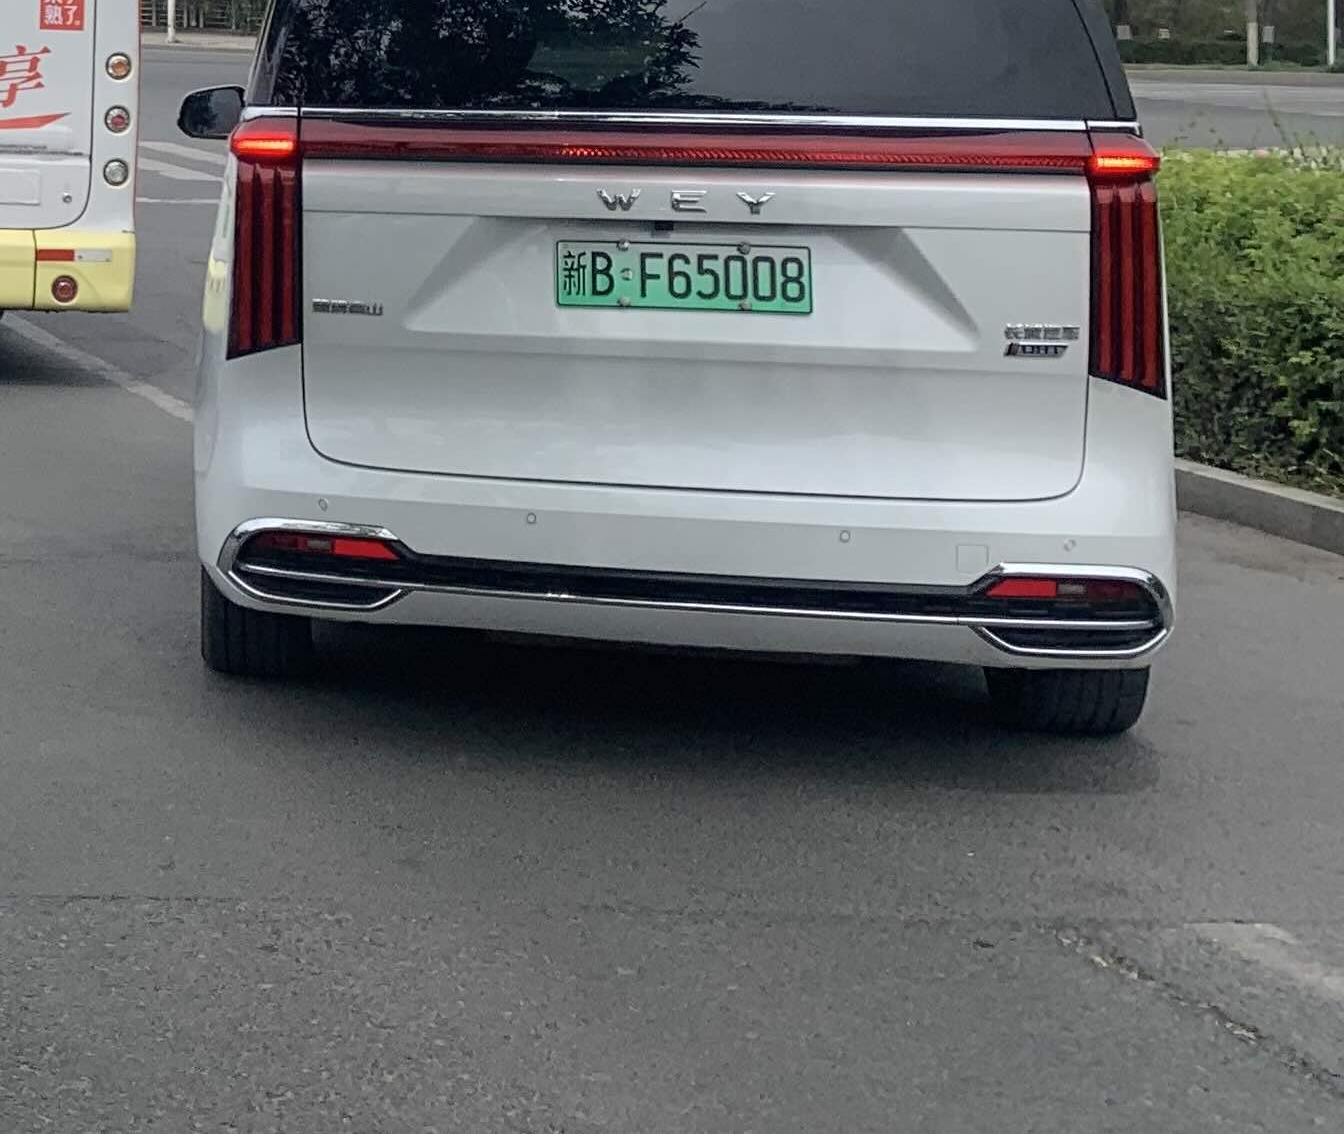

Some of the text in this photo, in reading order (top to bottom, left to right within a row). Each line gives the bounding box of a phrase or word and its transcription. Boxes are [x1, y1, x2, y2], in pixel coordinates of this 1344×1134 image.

[44, 4, 79, 26] 熟了
[596, 186, 776, 214] WEY
[563, 250, 806, 303] 新B F65008
